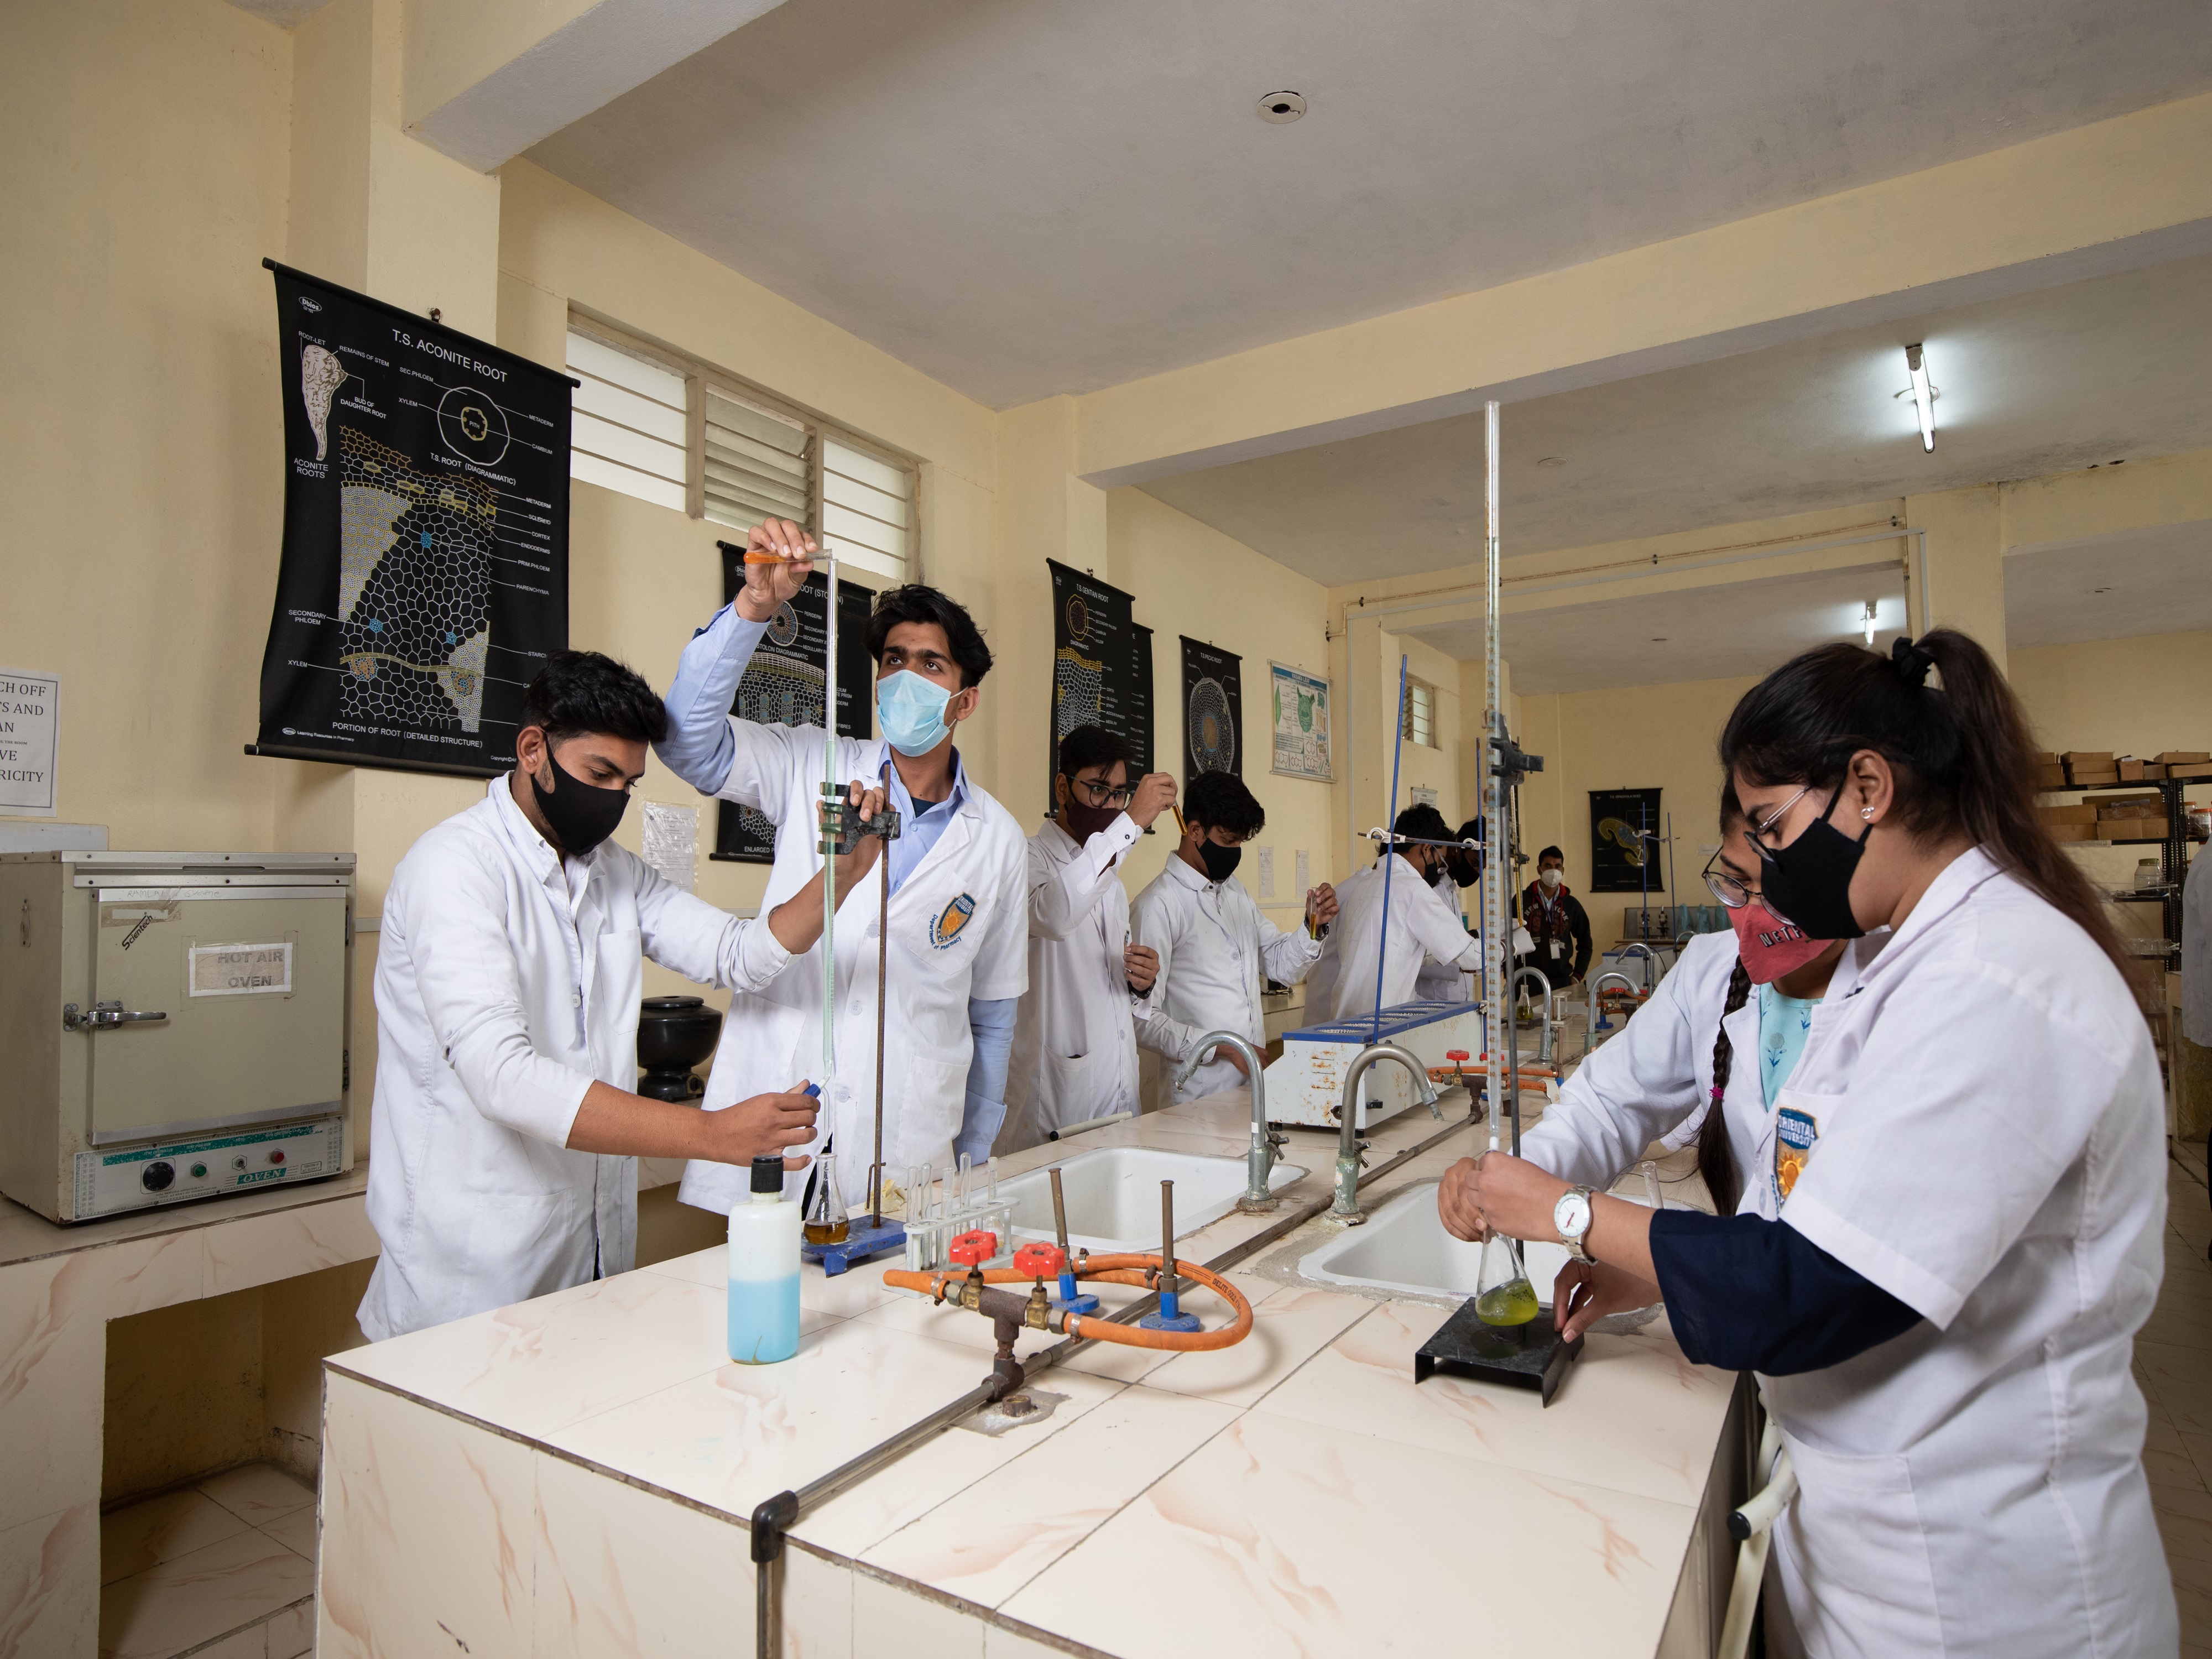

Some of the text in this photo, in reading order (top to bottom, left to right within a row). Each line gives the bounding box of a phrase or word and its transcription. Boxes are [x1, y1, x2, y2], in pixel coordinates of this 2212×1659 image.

[302, 298, 319, 310] Dbios
[298, 331, 326, 346] ROOT-LET
[339, 345, 366, 358] REMAINS
[374, 357, 389, 367] STEM
[392, 328, 508, 383] T.S. ACONITE ROOT
[354, 397, 366, 405] BUD
[399, 397, 418, 407] XYLEM
[340, 399, 387, 419] DAUGHTER ROOT
[469, 420, 480, 429] PITH
[529, 414, 554, 427] METADERM
[531, 444, 552, 455] CAMBIUM
[294, 458, 328, 471] ACONITE
[430, 452, 516, 486] T.S. ROOT (DIAGRAMMATIC)
[296, 466, 325, 478] ROOTS
[526, 498, 551, 509] METADERM
[531, 531, 550, 540] CORTEX
[516, 584, 549, 595] PARENCHYMA
[799, 585, 813, 594] OOT
[1098, 593, 1109, 603] ROOT
[288, 609, 326, 619] SECONDARY
[804, 611, 822, 620] PERIDERM
[804, 625, 825, 634] SECONDARY
[803, 634, 824, 644] SECONDARY
[757, 644, 808, 660] STOLON DIAGRAMMATIC
[802, 644, 824, 654] MEDULLARY
[1291, 672, 1303, 681] VASAKA
[19, 684, 46, 697] OFF
[0, 701, 44, 716] S AND
[332, 722, 366, 733] PORTION
[380, 728, 401, 737] ROOT
[404, 731, 439, 742] (DETAILED
[440, 736, 483, 749] STRUCTURE)
[955, 900, 971, 914] UNIVERSITY
[958, 896, 974, 911] ORIENTAL
[1524, 902, 1569, 921] NEW YORK
[122, 914, 153, 951] Scientech
[929, 914, 938, 946] Department
[940, 936, 962, 951] Pharmacy
[218, 951, 283, 964] HOT AIR
[228, 975, 272, 988] OVEN
[1778, 1115, 1815, 1139] ORIENTAL
[243, 1168, 282, 1183] OVEN
[1212, 1278, 1237, 1302] DELITE GOLD
